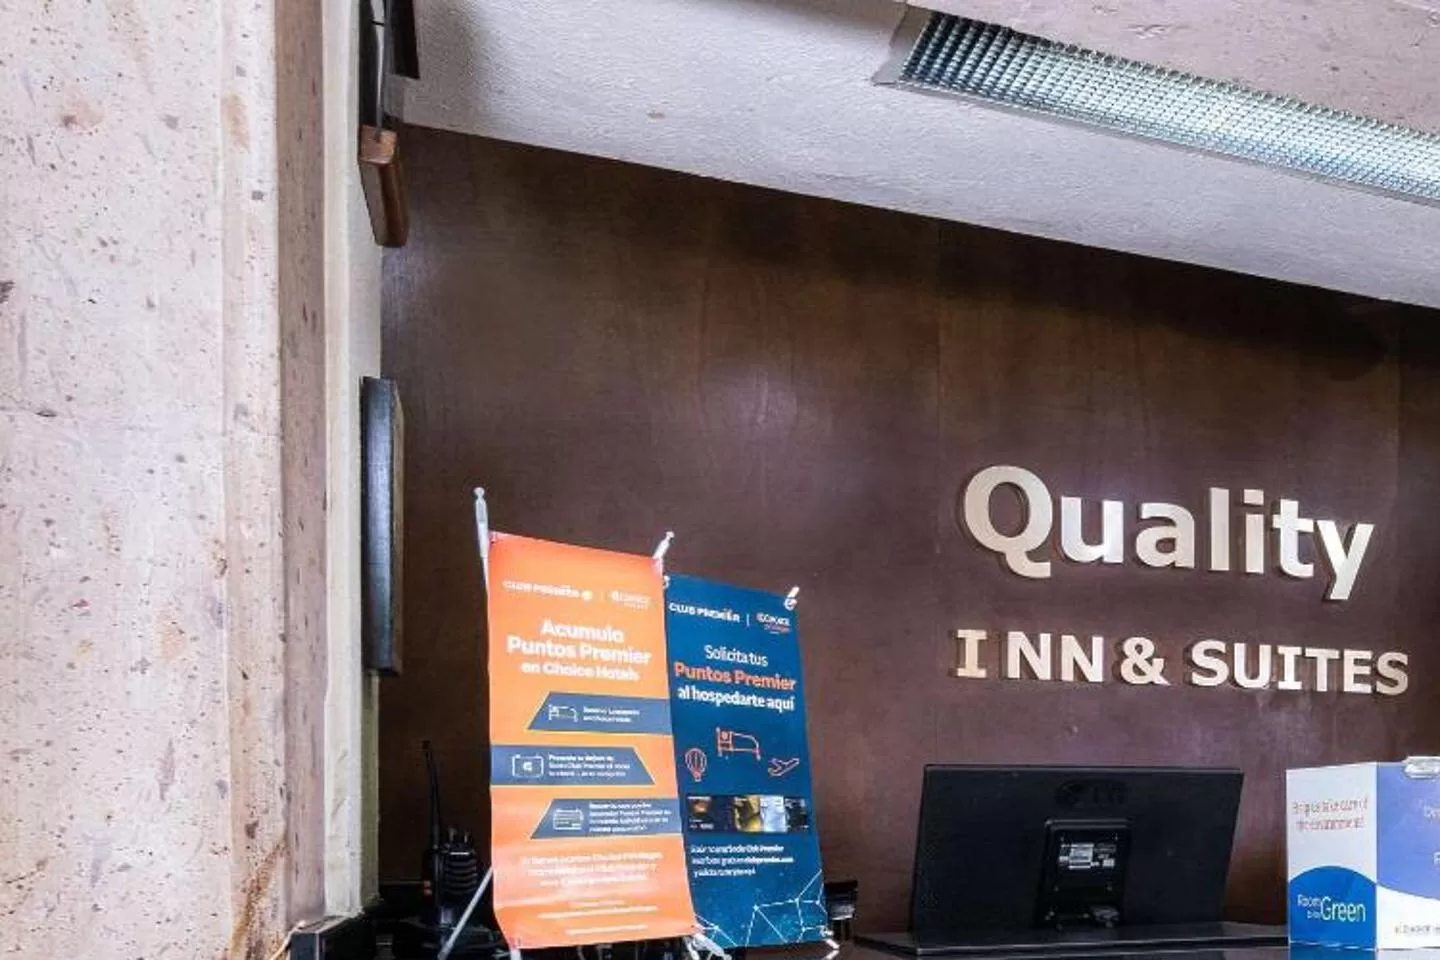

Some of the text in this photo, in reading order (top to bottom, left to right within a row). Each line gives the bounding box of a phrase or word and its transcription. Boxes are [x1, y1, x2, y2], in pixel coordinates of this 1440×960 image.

[963, 464, 1375, 601] Quality
[668, 602, 696, 616] CLUB
[540, 619, 625, 644] Acumula
[506, 635, 653, 665] Puntos Premier
[704, 644, 769, 667] Solicita tus
[954, 628, 1410, 696] INN & SUITES
[520, 661, 641, 682] en Choice Hotels
[673, 661, 797, 691] Puntos Premier
[677, 684, 690, 700] al
[691, 684, 765, 707] hospedarte
[1320, 895, 1367, 922] Green
